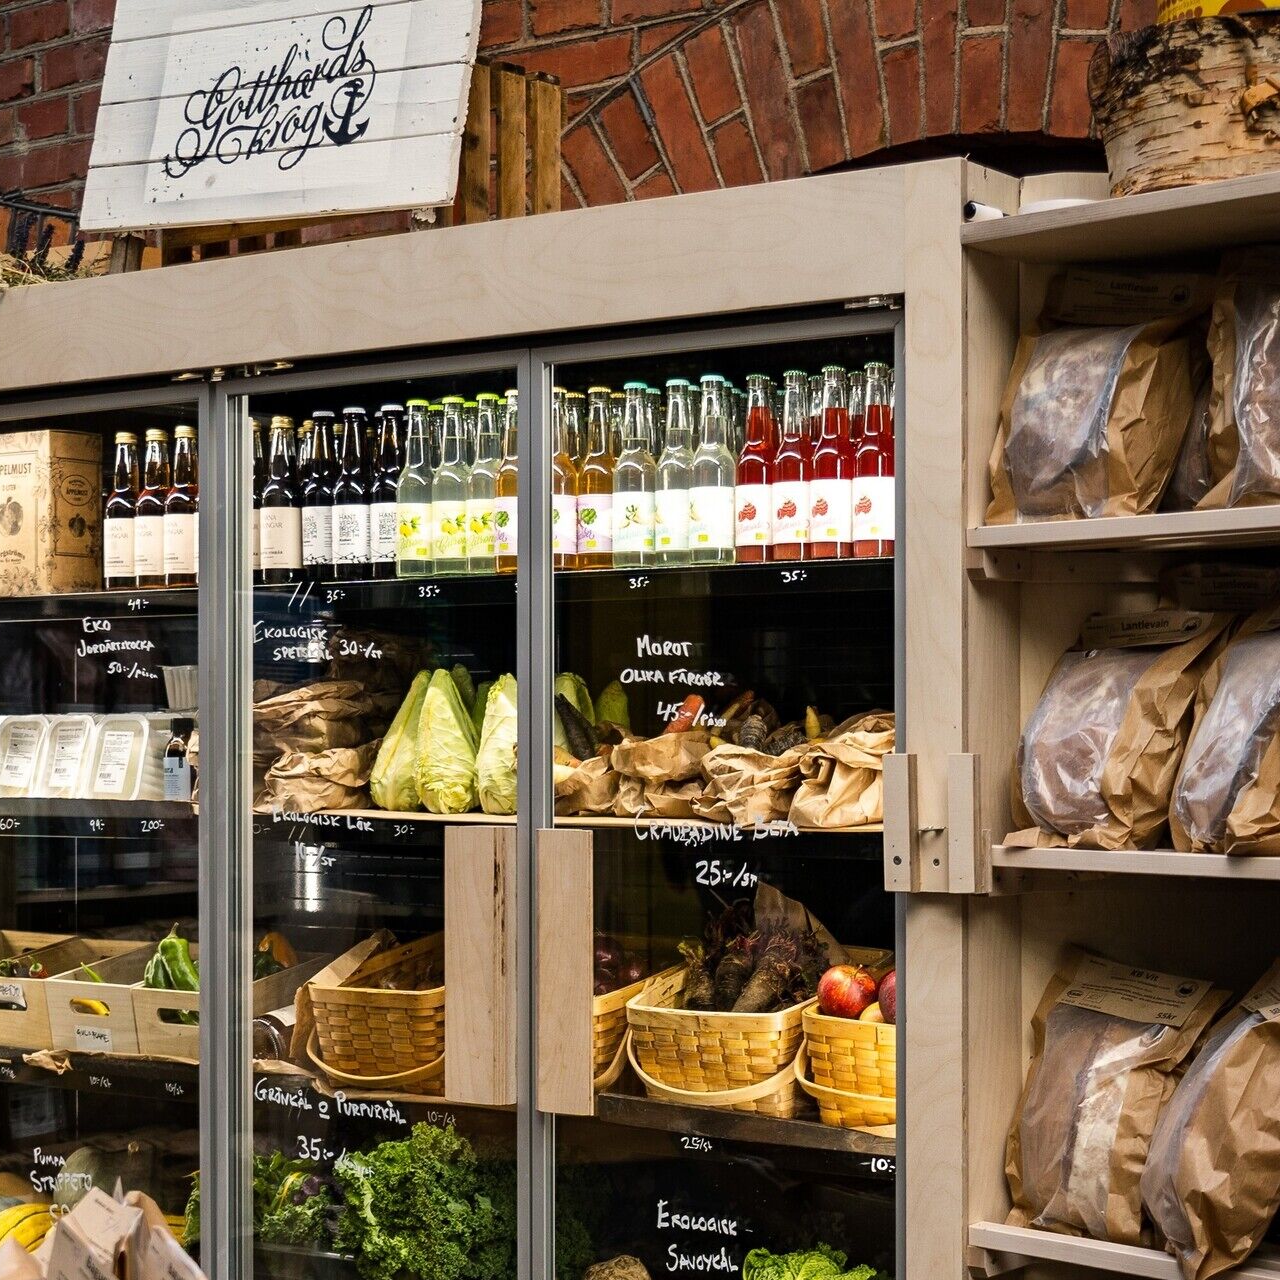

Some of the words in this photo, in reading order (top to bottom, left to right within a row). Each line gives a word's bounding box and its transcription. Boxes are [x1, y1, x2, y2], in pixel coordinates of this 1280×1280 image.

[81, 616, 112, 634] EKO
[253, 620, 329, 644] EKOLOGISK
[1120, 619, 1170, 631] Lantlevain
[636, 634, 693, 657] MOROT
[620, 668, 664, 684] OLIKA
[272, 803, 340, 827] EKOLOGISK
[254, 1077, 313, 1110] GRÖNKÅL
[33, 1146, 67, 1166] PUMPA
[656, 1199, 738, 1236] EKOLOGISK
[665, 1244, 739, 1272] SAVOYKÅL
